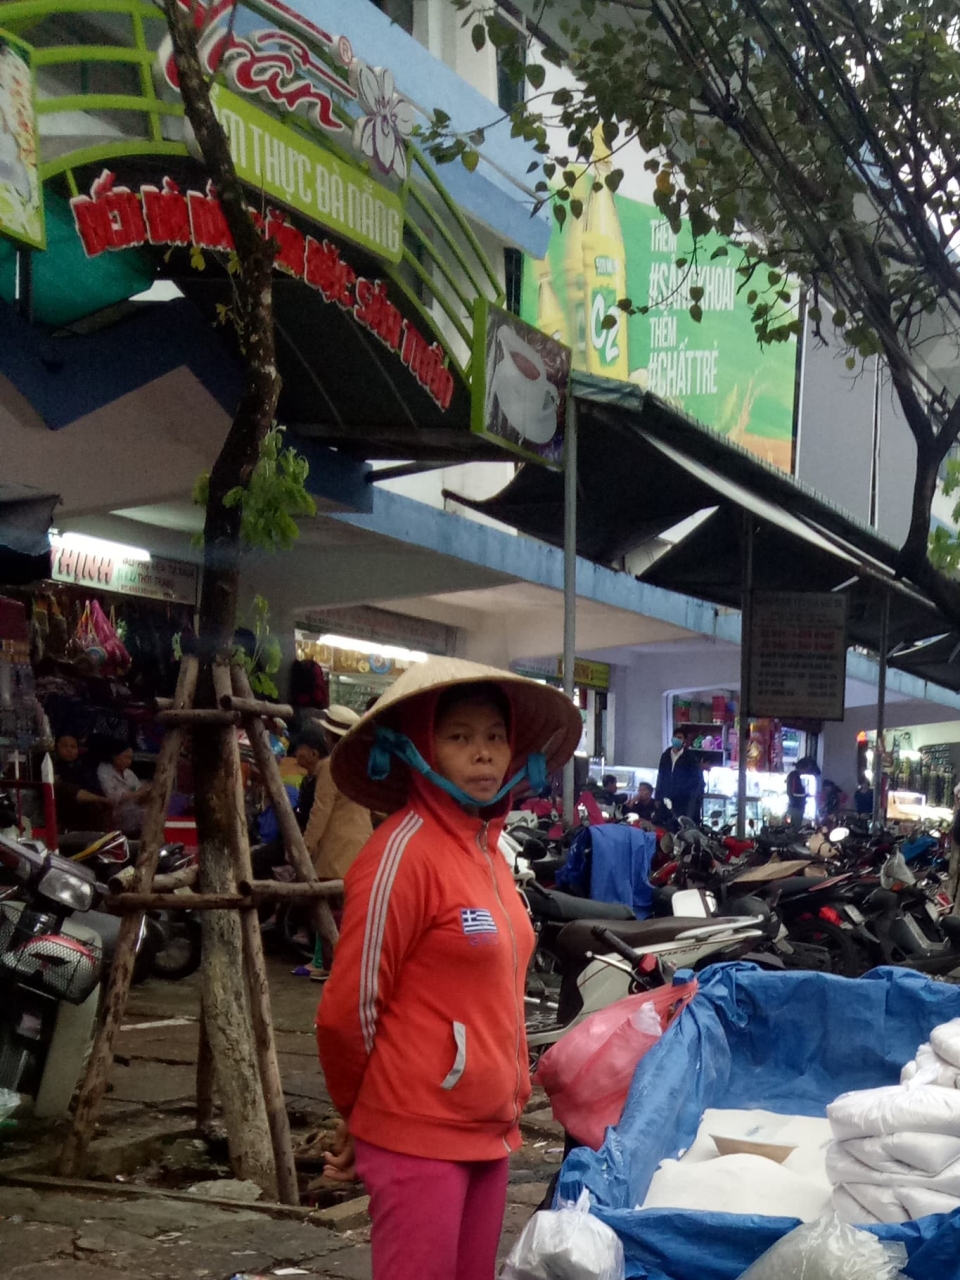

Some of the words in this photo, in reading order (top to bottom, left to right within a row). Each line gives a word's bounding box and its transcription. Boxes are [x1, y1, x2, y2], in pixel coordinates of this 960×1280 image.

[250, 124, 312, 204] THỰC
[316, 161, 345, 223] ĐÀ
[348, 177, 400, 254] NẴNG
[650, 310, 677, 348] THÊM
